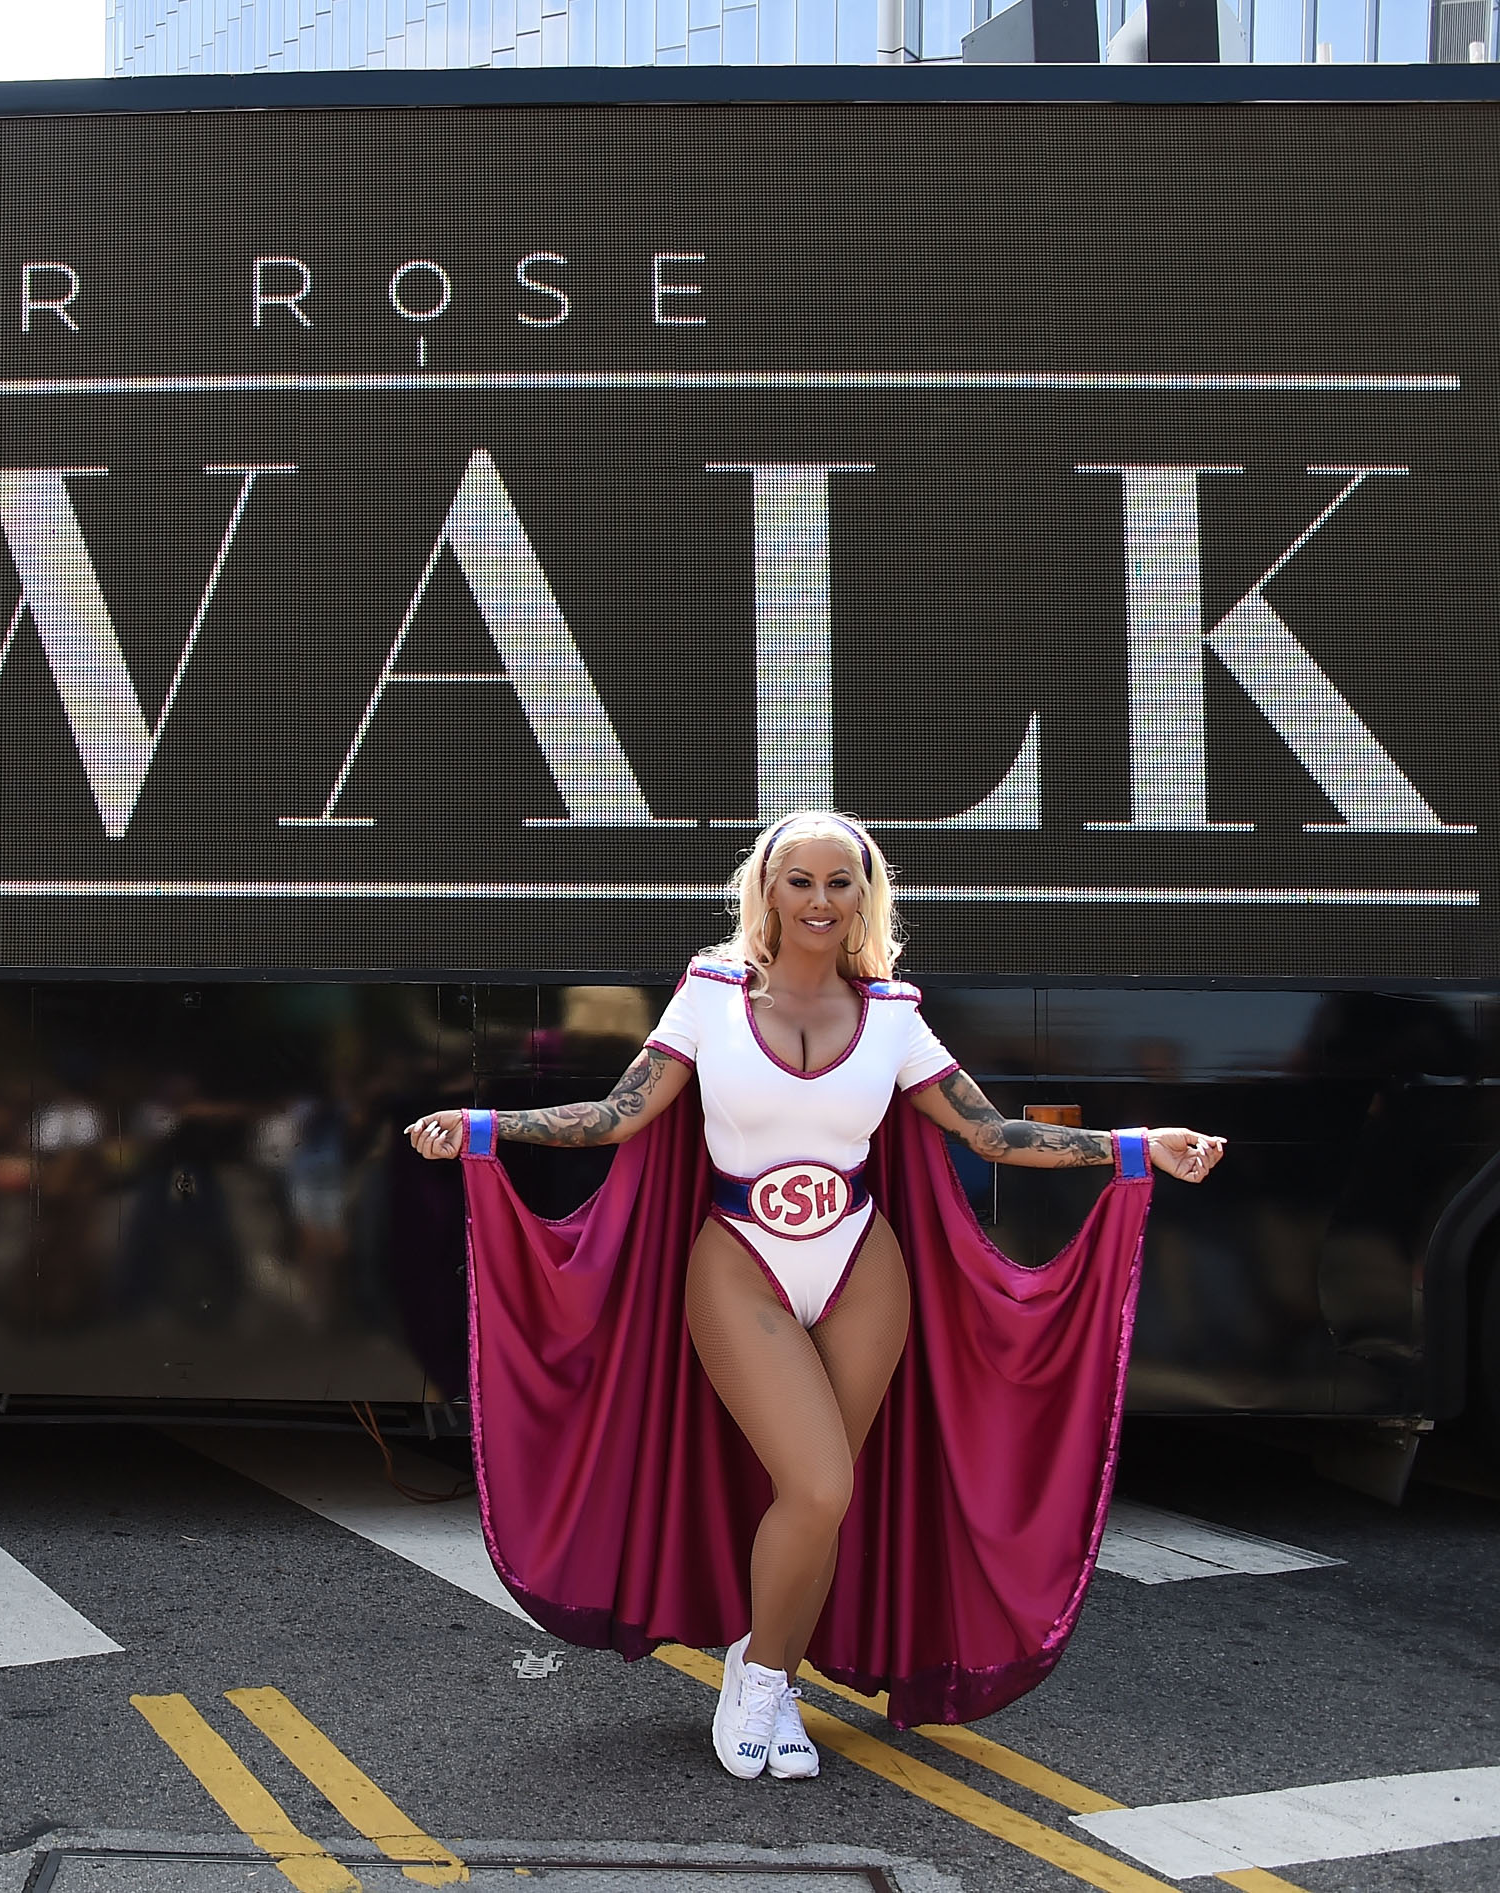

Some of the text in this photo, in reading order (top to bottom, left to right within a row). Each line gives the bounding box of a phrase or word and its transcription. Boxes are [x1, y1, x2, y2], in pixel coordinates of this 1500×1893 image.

[251, 250, 709, 328] ROSE
[760, 1175, 837, 1226] CSH
[738, 1742, 766, 1759] SLUT
[778, 1744, 813, 1755] WALK
